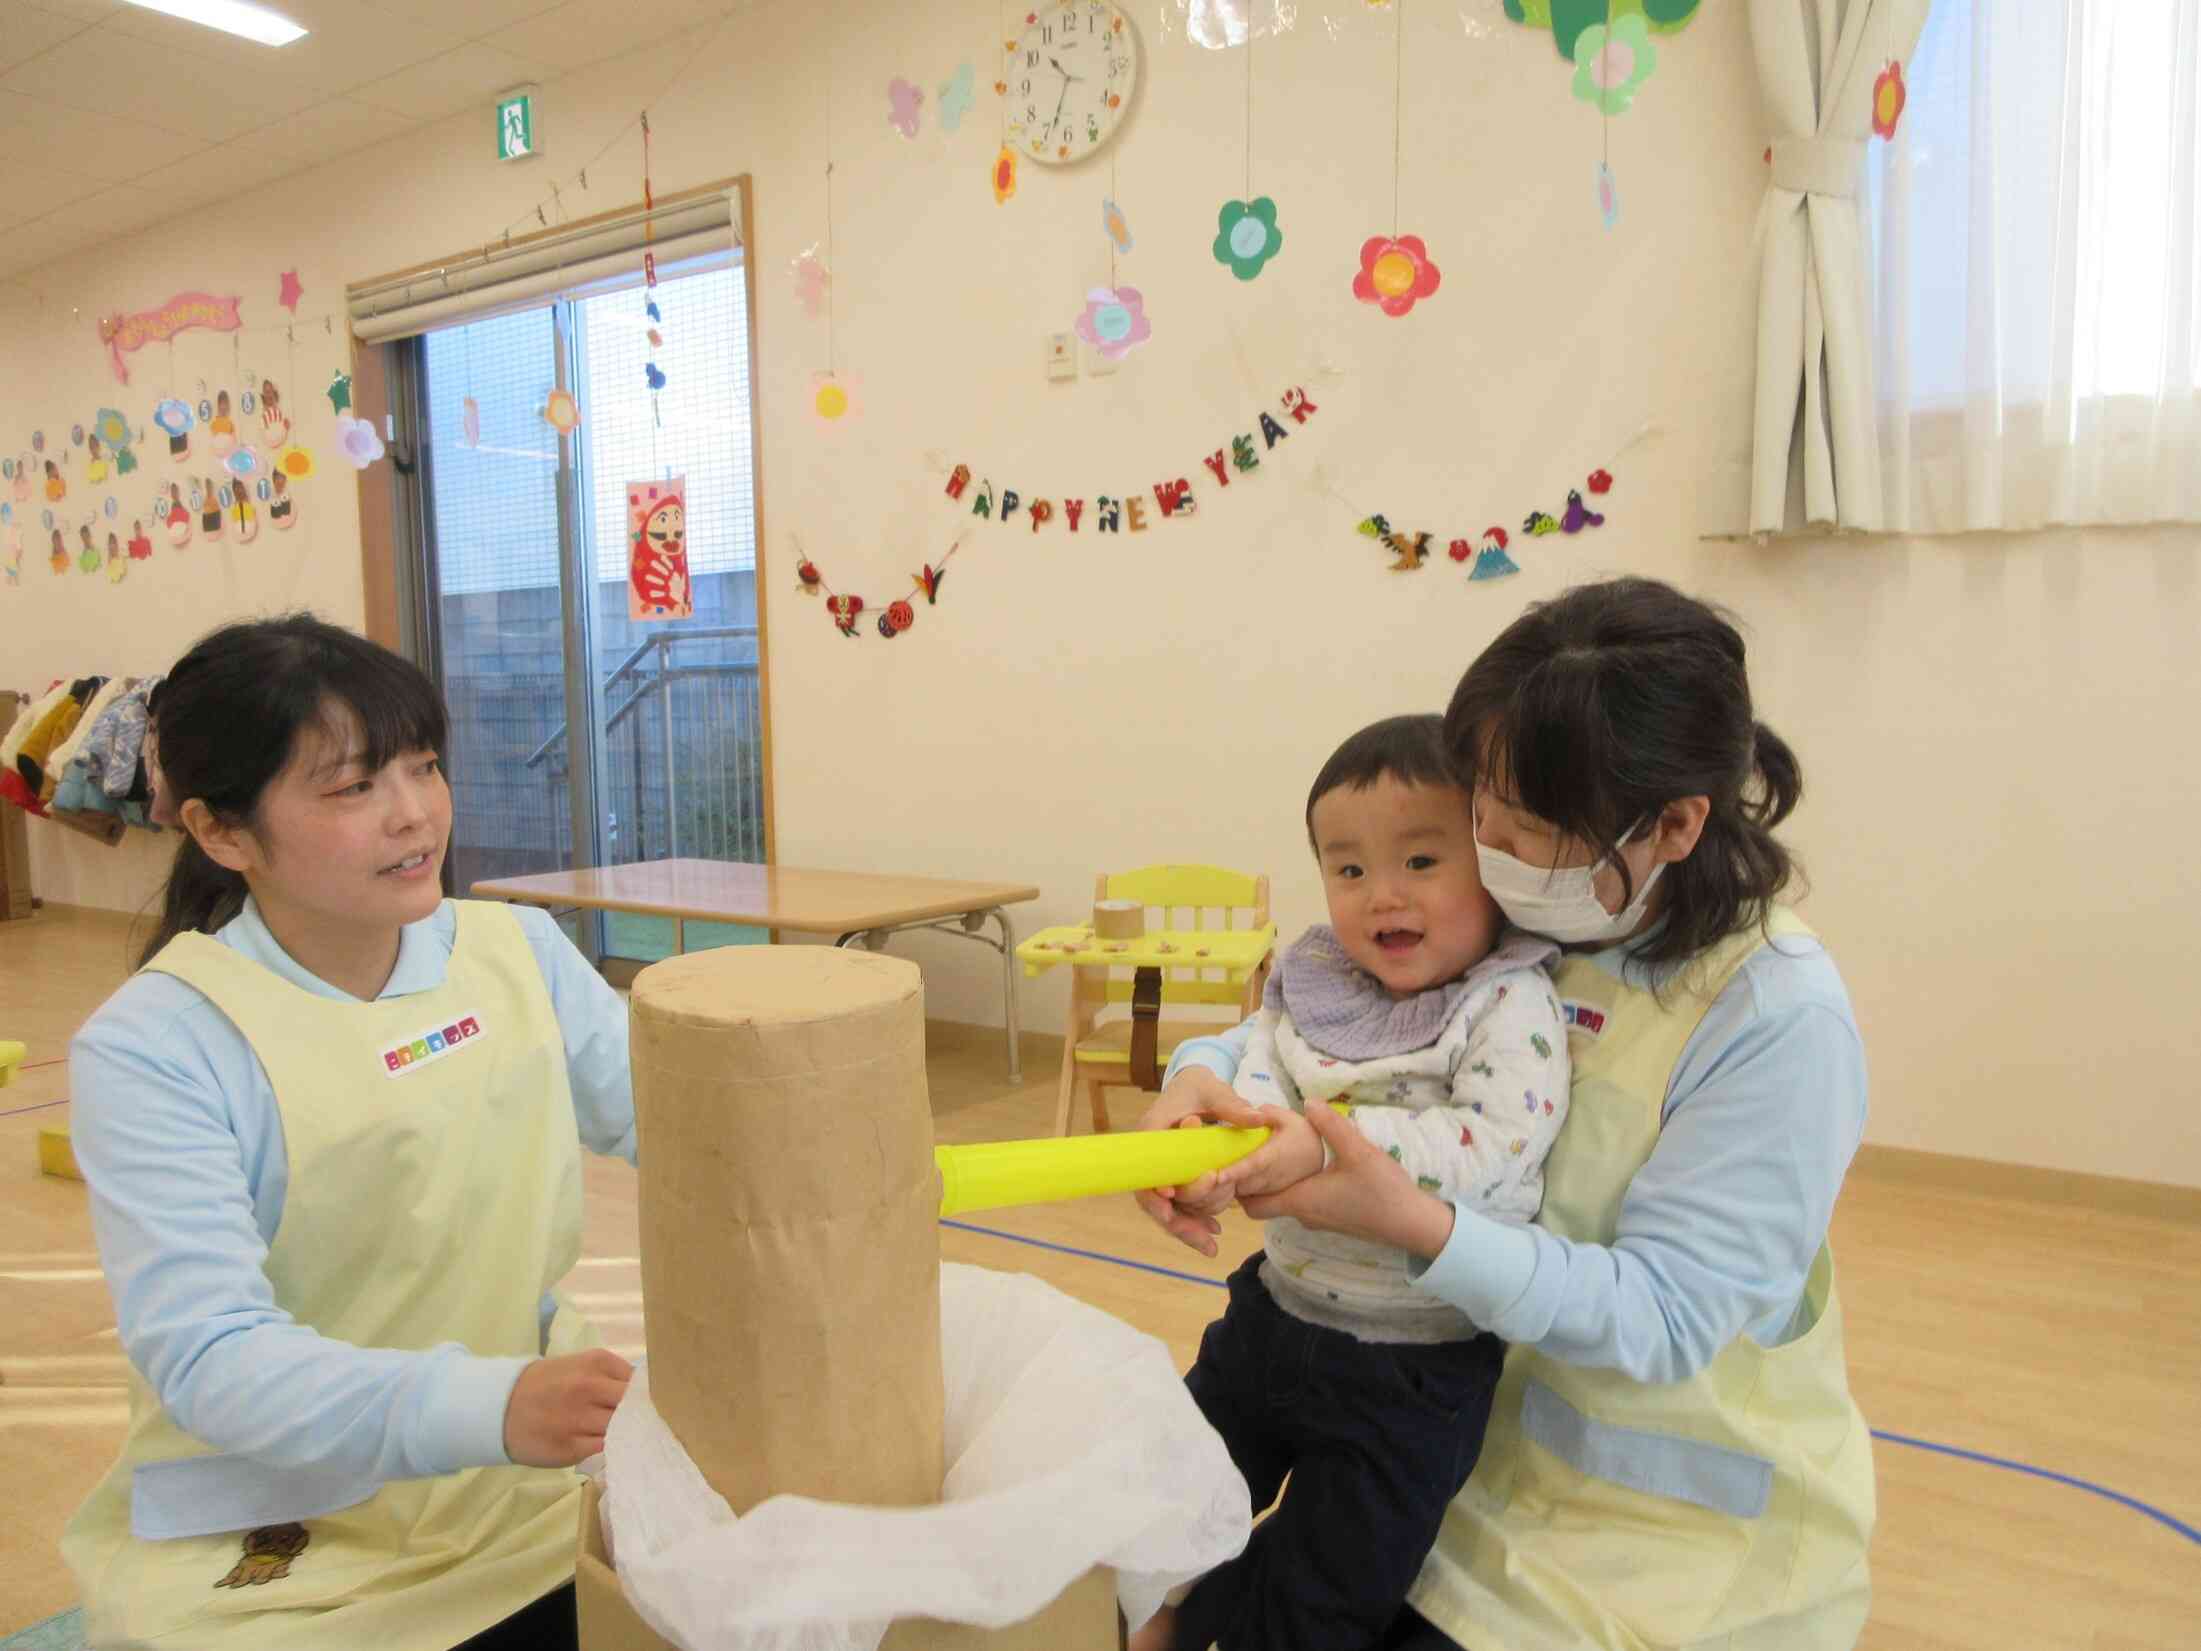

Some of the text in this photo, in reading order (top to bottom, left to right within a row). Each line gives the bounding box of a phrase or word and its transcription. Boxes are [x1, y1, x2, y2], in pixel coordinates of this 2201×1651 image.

[1062, 12, 1077, 32] 12
[1042, 26, 1053, 45] 11
[1026, 49, 1040, 69] 10
[1021, 79, 1031, 96] 9
[1026, 105, 1037, 123] 8
[1042, 122, 1051, 141] 7
[1063, 127, 1073, 143] 6
[945, 385, 1318, 533] HAPPY NEW YEAR
